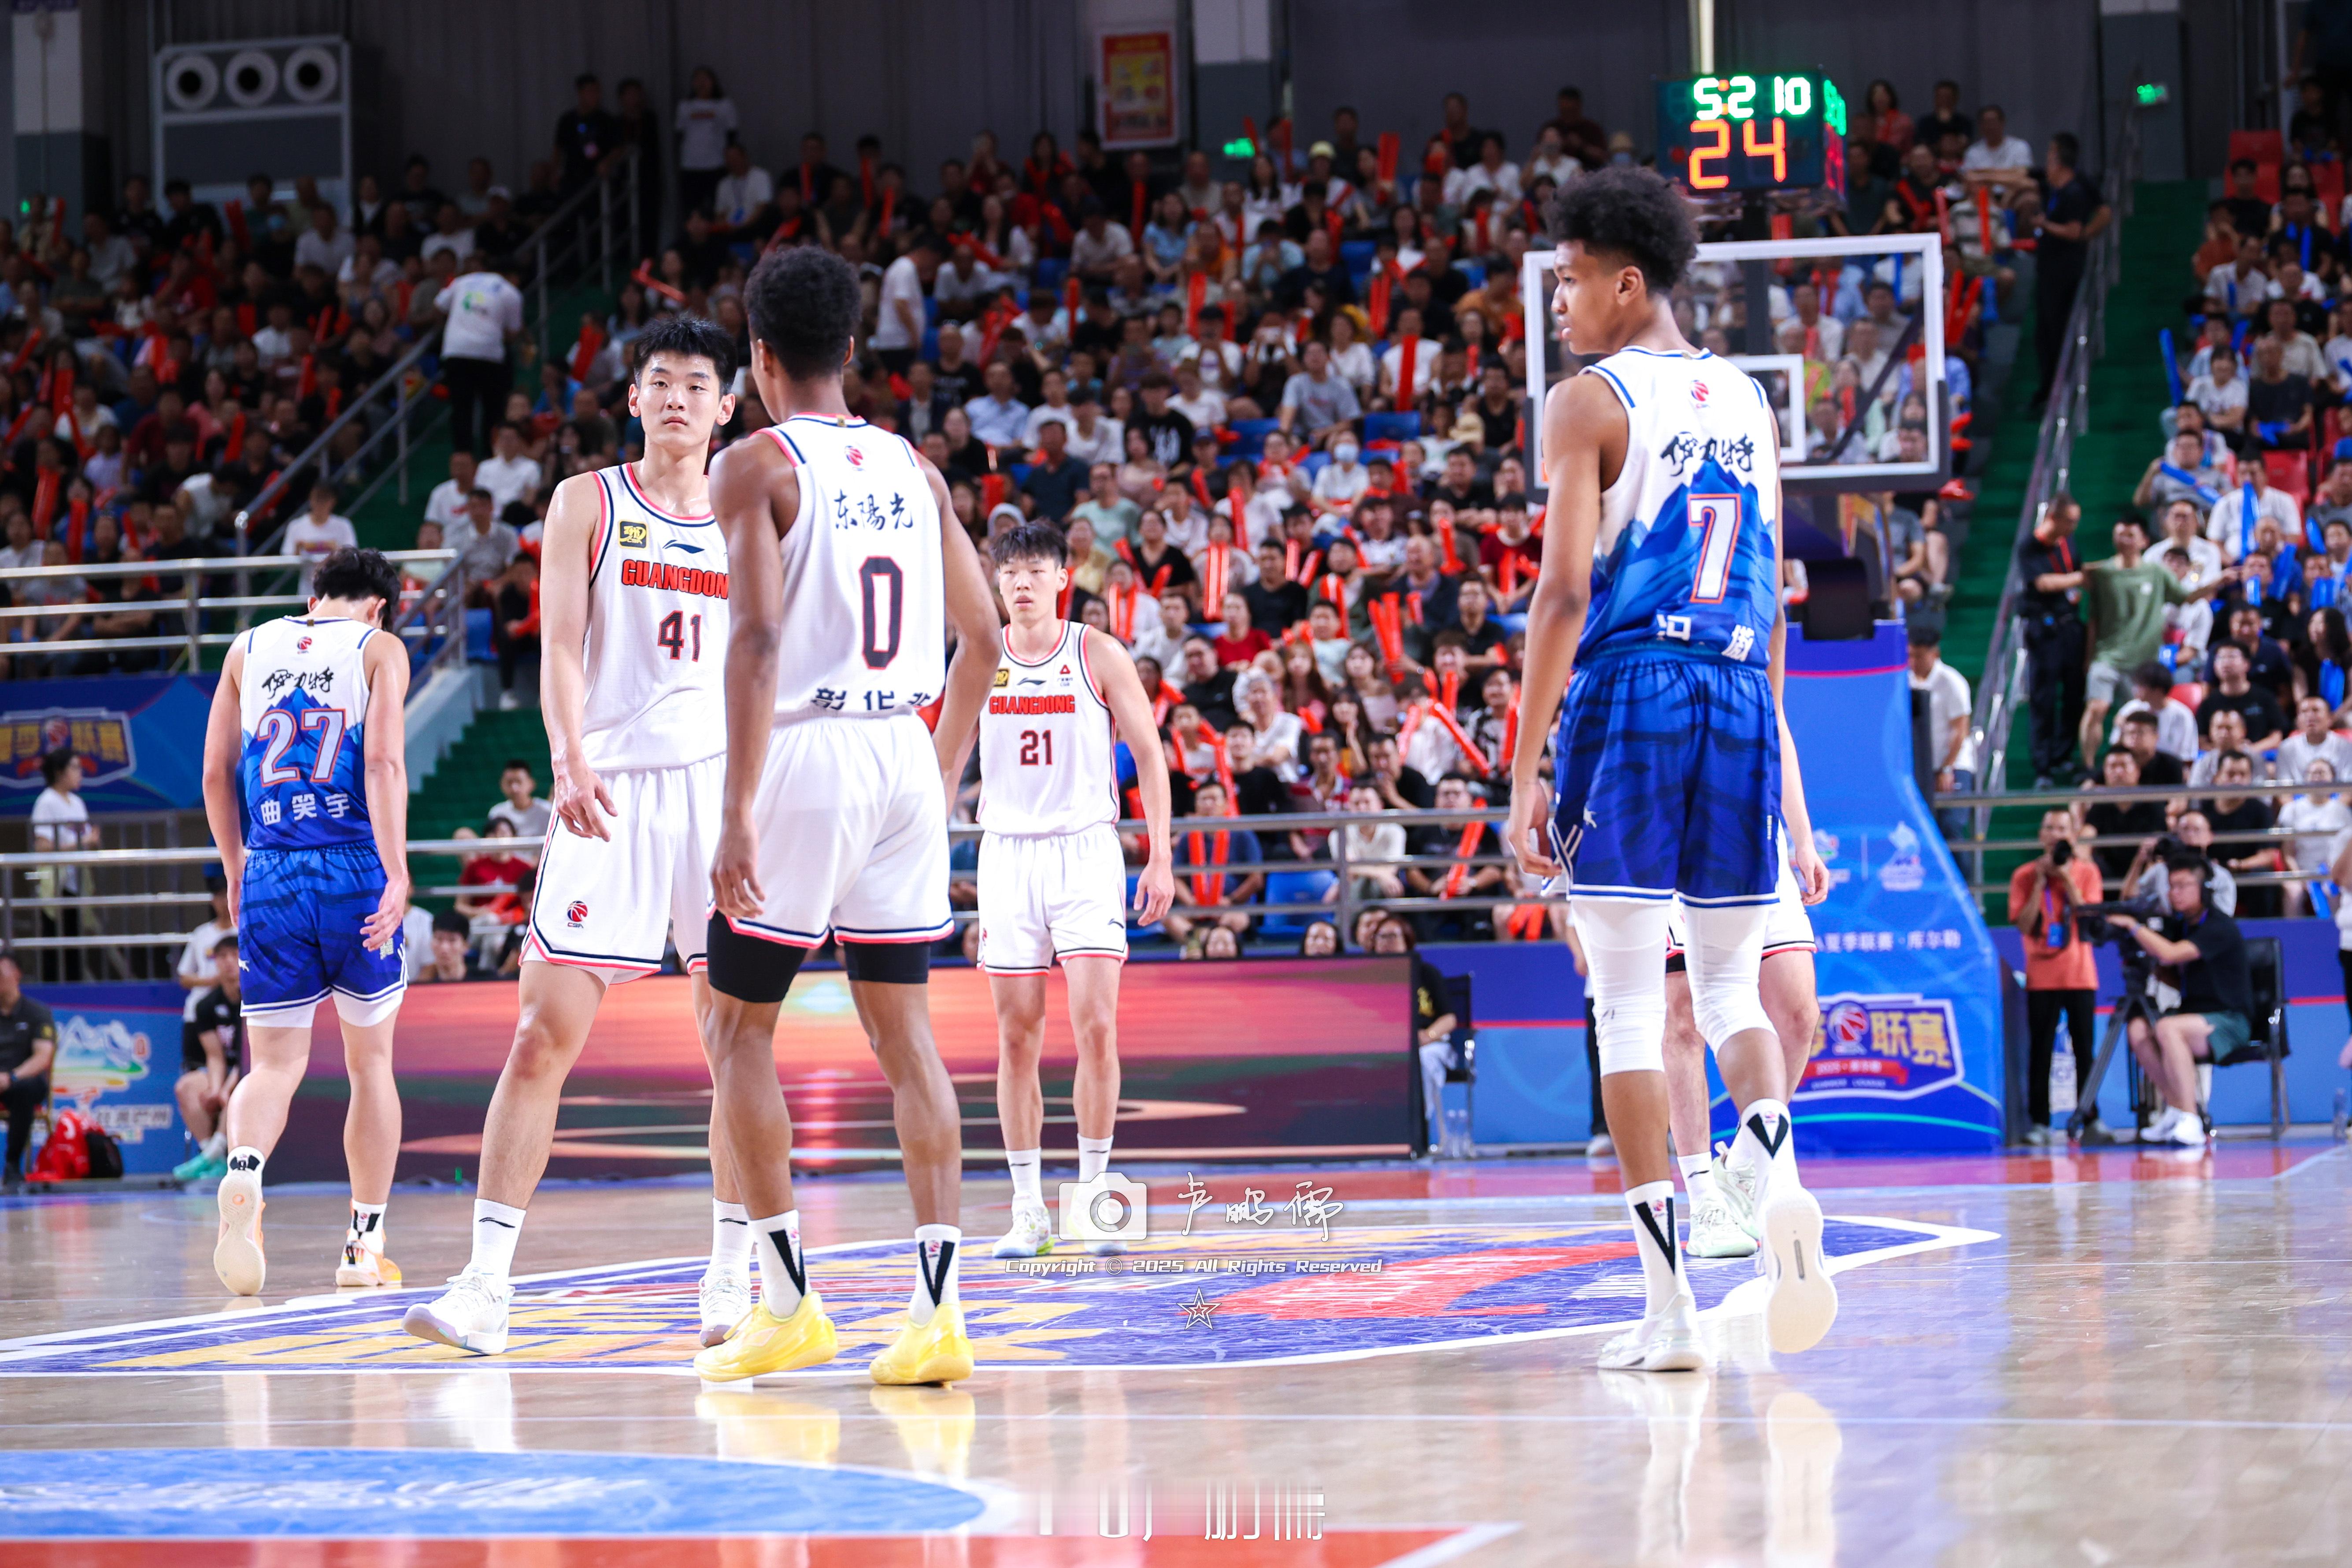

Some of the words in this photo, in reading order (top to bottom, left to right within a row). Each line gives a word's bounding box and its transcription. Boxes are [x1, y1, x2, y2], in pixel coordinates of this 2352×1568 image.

[1774, 76, 1811, 115] 10
[1689, 117, 1786, 189] 24
[1687, 493, 1741, 604] 7
[622, 559, 729, 600] GUANGDON
[658, 610, 701, 663] 41
[859, 556, 903, 670] 0
[989, 695, 1075, 715] GUANGDONG
[257, 708, 346, 787] 27
[1020, 730, 1052, 765] 21
